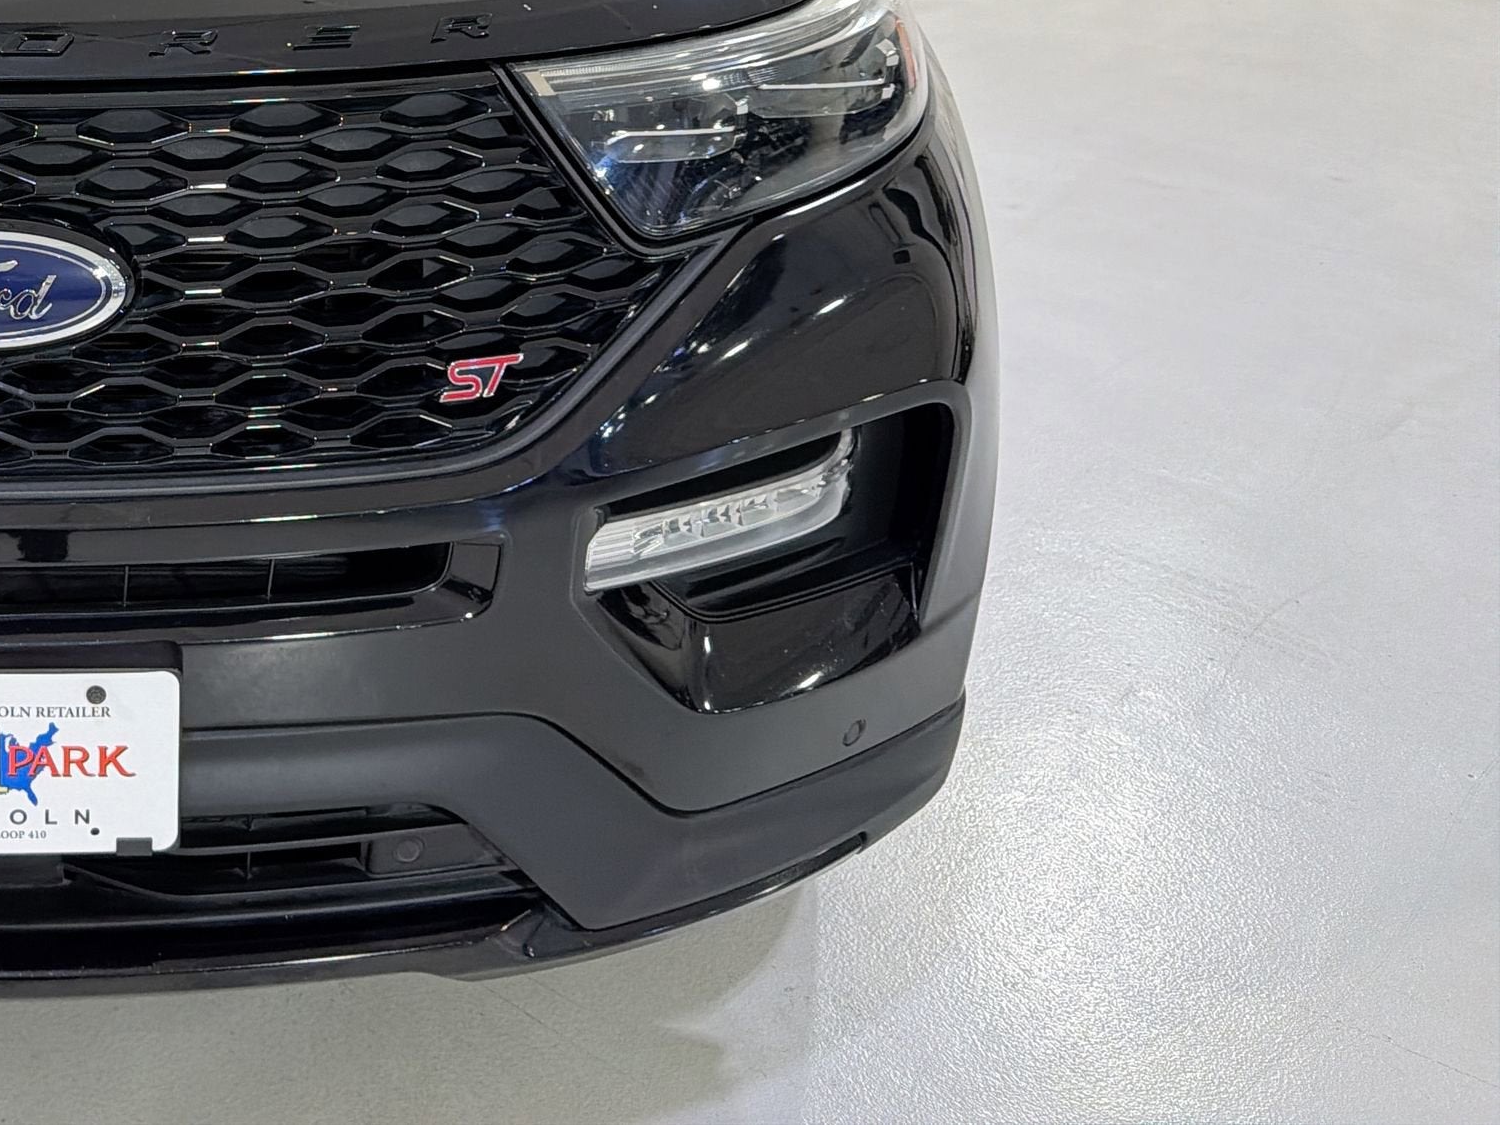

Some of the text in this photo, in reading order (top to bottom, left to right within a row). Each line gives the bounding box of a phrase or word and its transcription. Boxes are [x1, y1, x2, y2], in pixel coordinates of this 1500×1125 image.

[439, 353, 524, 403] ST
[35, 706, 111, 719] RETAILER
[7, 745, 136, 778] PARK
[28, 831, 47, 840] 410
